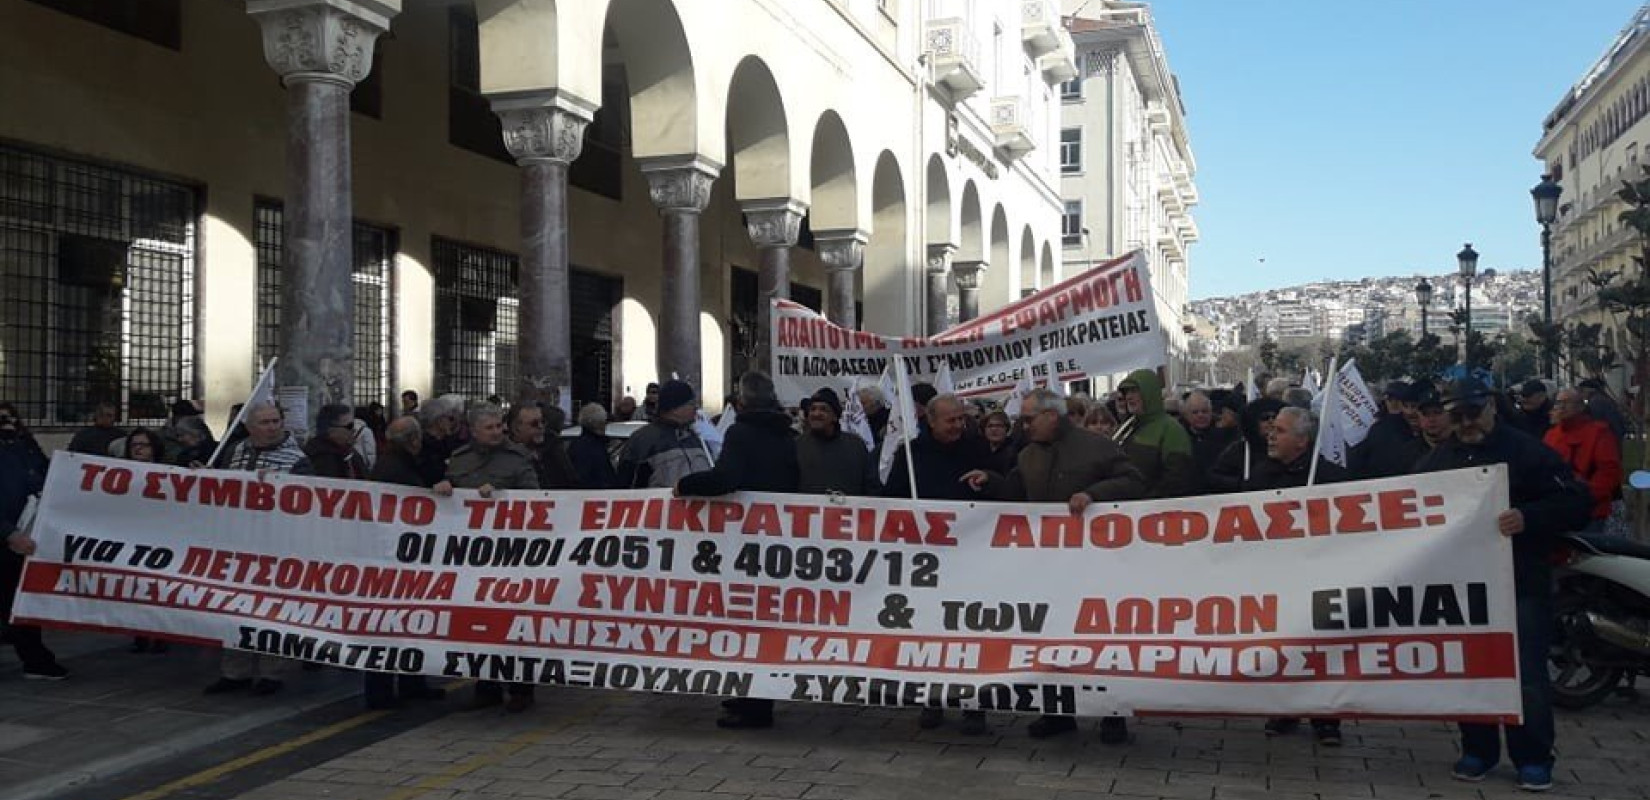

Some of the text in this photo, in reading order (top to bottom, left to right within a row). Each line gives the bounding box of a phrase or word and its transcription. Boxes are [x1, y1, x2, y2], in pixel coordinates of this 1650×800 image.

[777, 355, 798, 375] ΤΩΝ
[803, 356, 887, 376] ΑΠΟΦΑΣΕΩΝ
[892, 355, 921, 375] ΟΥ
[1039, 310, 1151, 353] ΕΠΙΚΡΑΤΕΙΑΣ
[778, 316, 887, 350] ΑΠΑΙΤΟΥΜΕ
[1001, 268, 1143, 336] ΕΦΑΡΜΟΓΗ
[80, 463, 1446, 549] ΤΟ ΣΥΜΒΟΥΛΙΟ ΤΗΣ ΕΠΙΚΡΑΤΕΙΑΣ ΑΠΟΦΑΣΙΣΕ:
[64, 534, 1490, 636] για το ΠΕΤΣΟΚΟΜΜΑ των ΣΥΝΤΑΞΕΩΝ & των ΔΩΡΩΝ ΕΙΝΑΙ
[396, 531, 939, 588] ΟΙ ΝΟΜΟΙ 4051 & 4093/12
[54, 568, 453, 636] ΑΝΤΙΣΥΝΤΑΓΜΑΤΙΚΟΙ
[506, 615, 761, 660] ΑΝΙΣΧΥΡΟΙ
[783, 634, 873, 664] ΚΑΙ
[896, 641, 981, 670] ΜΗ
[1008, 640, 1466, 678] ΕΦΑΡΜΟΣΤΕΟΙ
[238, 625, 424, 673] ΣΩΜΑΤΕΙΟ
[443, 651, 754, 697] ΣΥΝΤΑΞΙΟΥΧΩΝ
